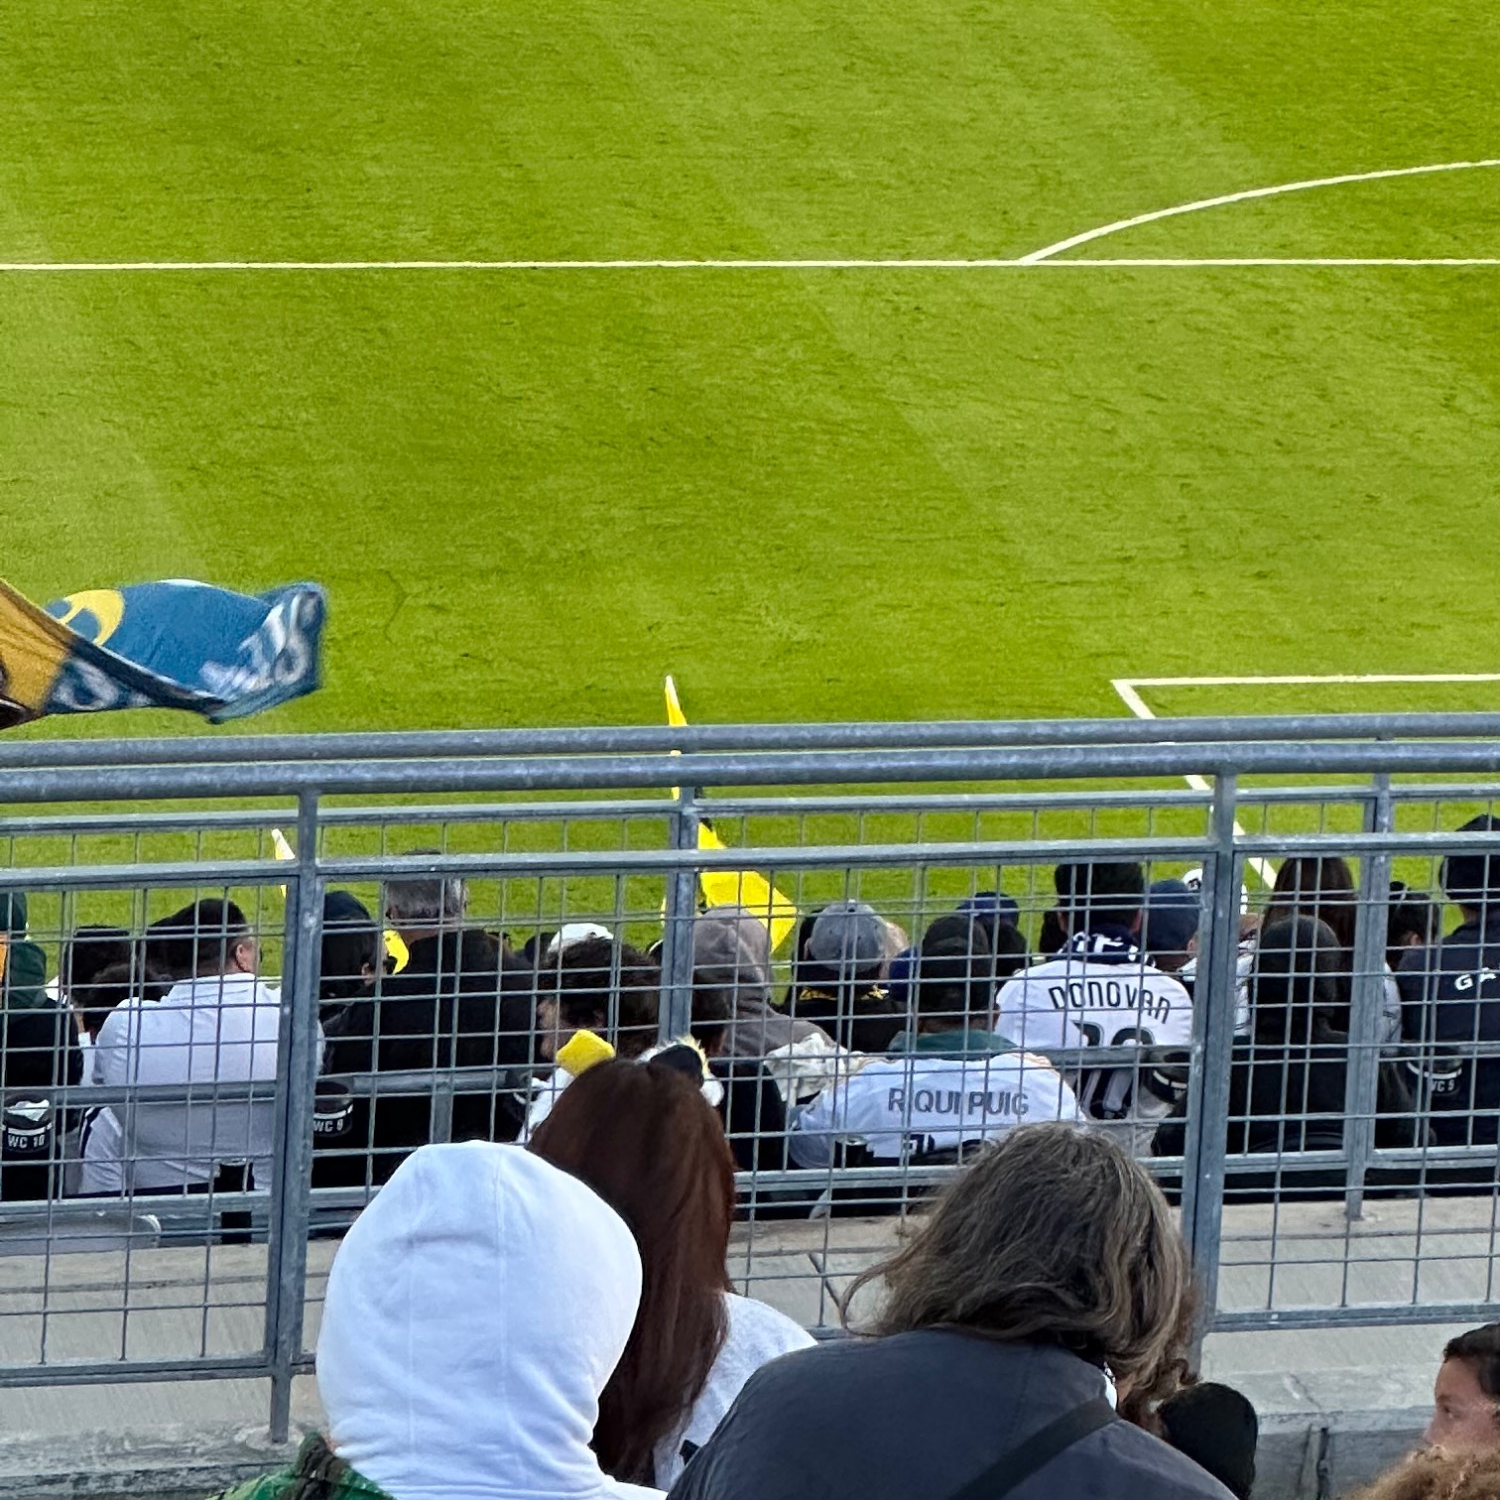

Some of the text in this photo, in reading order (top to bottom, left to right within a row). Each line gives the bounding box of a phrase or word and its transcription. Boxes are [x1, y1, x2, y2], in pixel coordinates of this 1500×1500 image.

[1048, 981, 1171, 1025] DONOVAN
[888, 1088, 1030, 1116] RQUI PUIG
[313, 1120, 333, 1132] WC
[7, 1134, 46, 1149] WC 10
